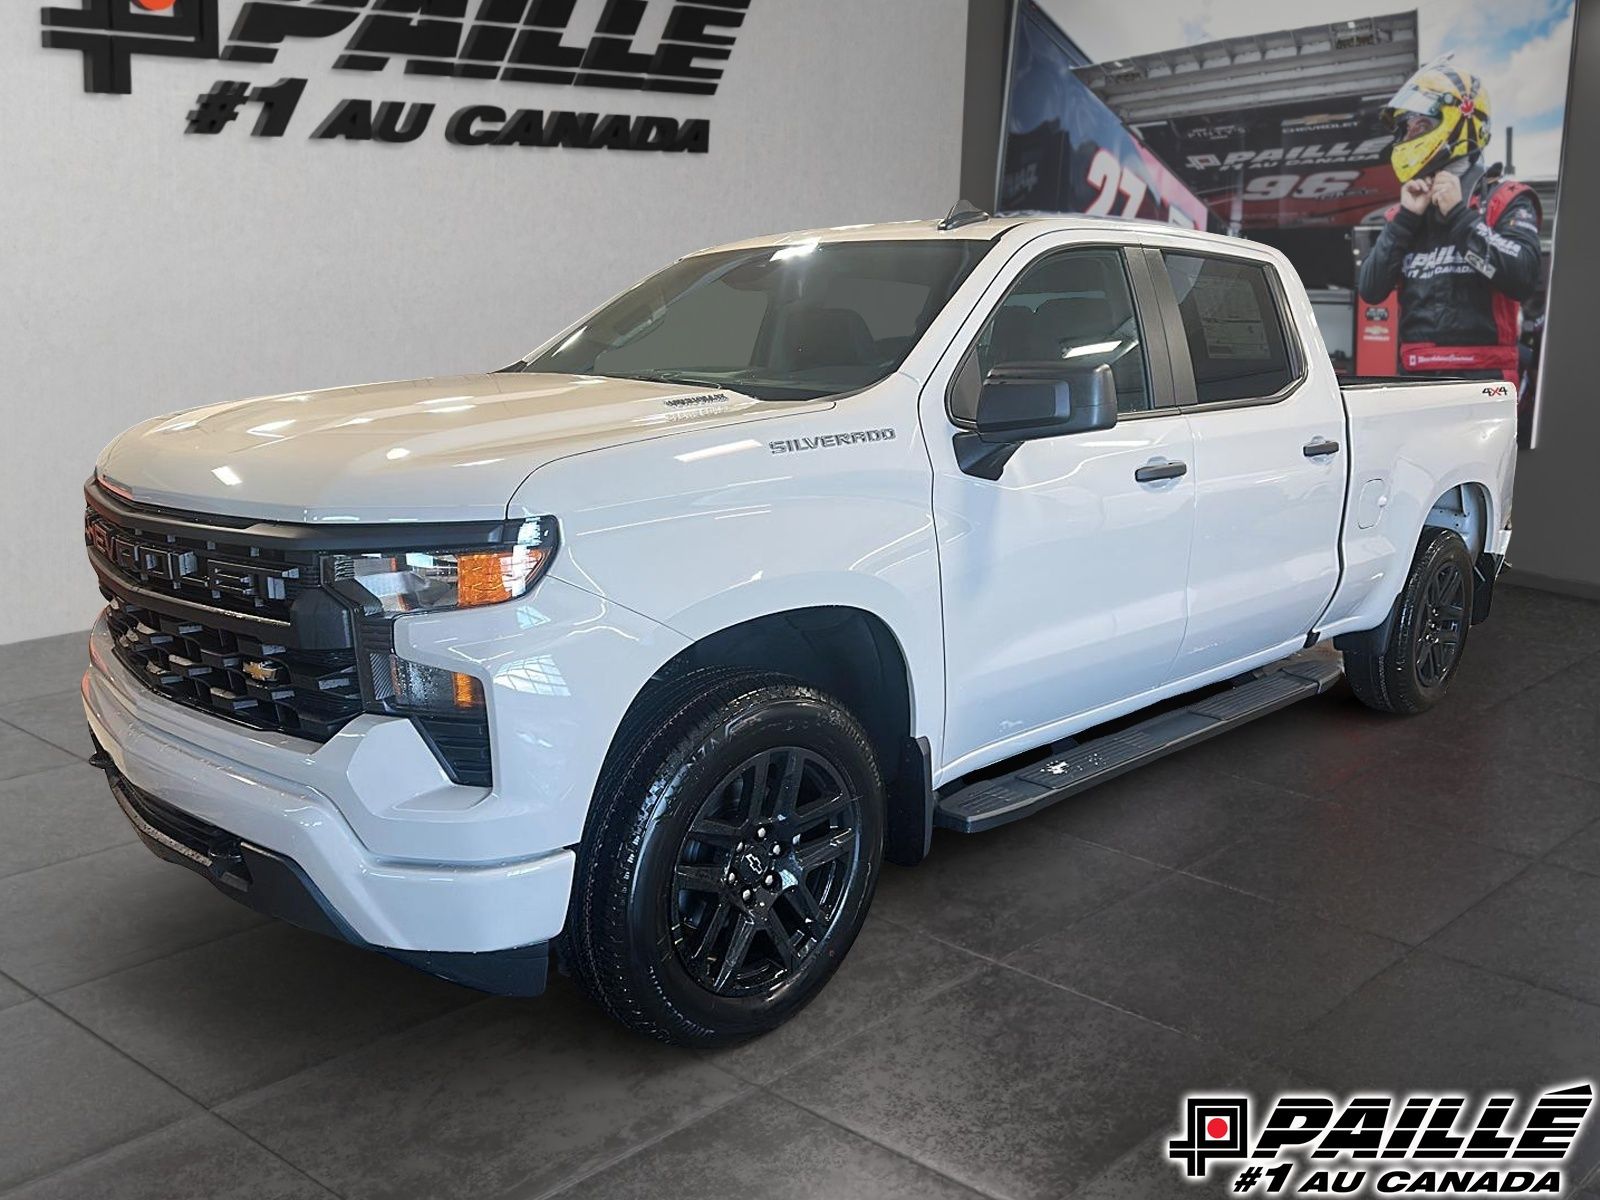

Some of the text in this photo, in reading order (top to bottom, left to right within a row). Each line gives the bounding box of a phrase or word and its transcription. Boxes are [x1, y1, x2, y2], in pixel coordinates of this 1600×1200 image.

[184, 78, 710, 153] #1 AU CANADA
[1282, 122, 1359, 133] CHEVROLET
[1285, 154, 1379, 166] CANADA
[1086, 149, 1147, 219] 27
[1243, 170, 1361, 201] 96
[769, 427, 896, 455] SILVERADO
